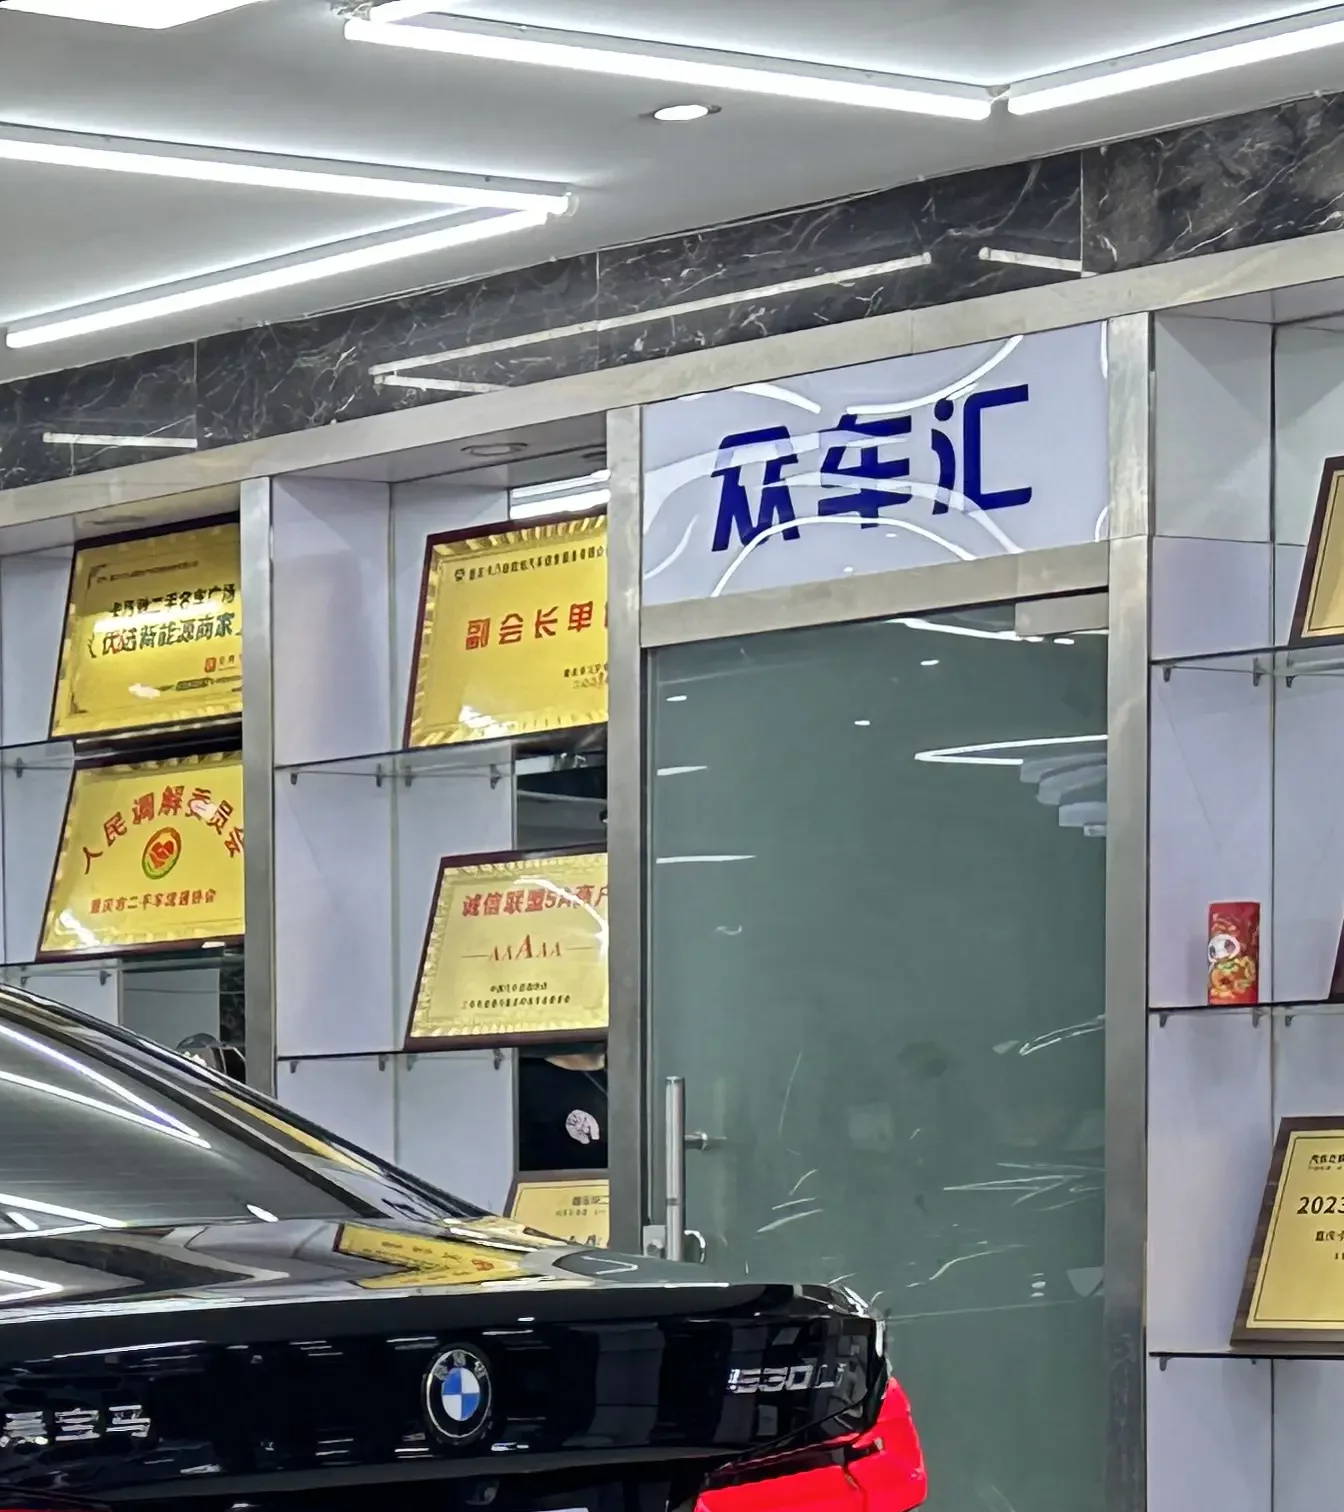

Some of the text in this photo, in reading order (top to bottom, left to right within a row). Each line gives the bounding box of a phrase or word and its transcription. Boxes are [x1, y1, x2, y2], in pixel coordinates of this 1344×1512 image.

[710, 383, 1032, 552] 众车汇
[465, 600, 608, 650] 副会长单
[727, 1362, 847, 1394] 530Li
